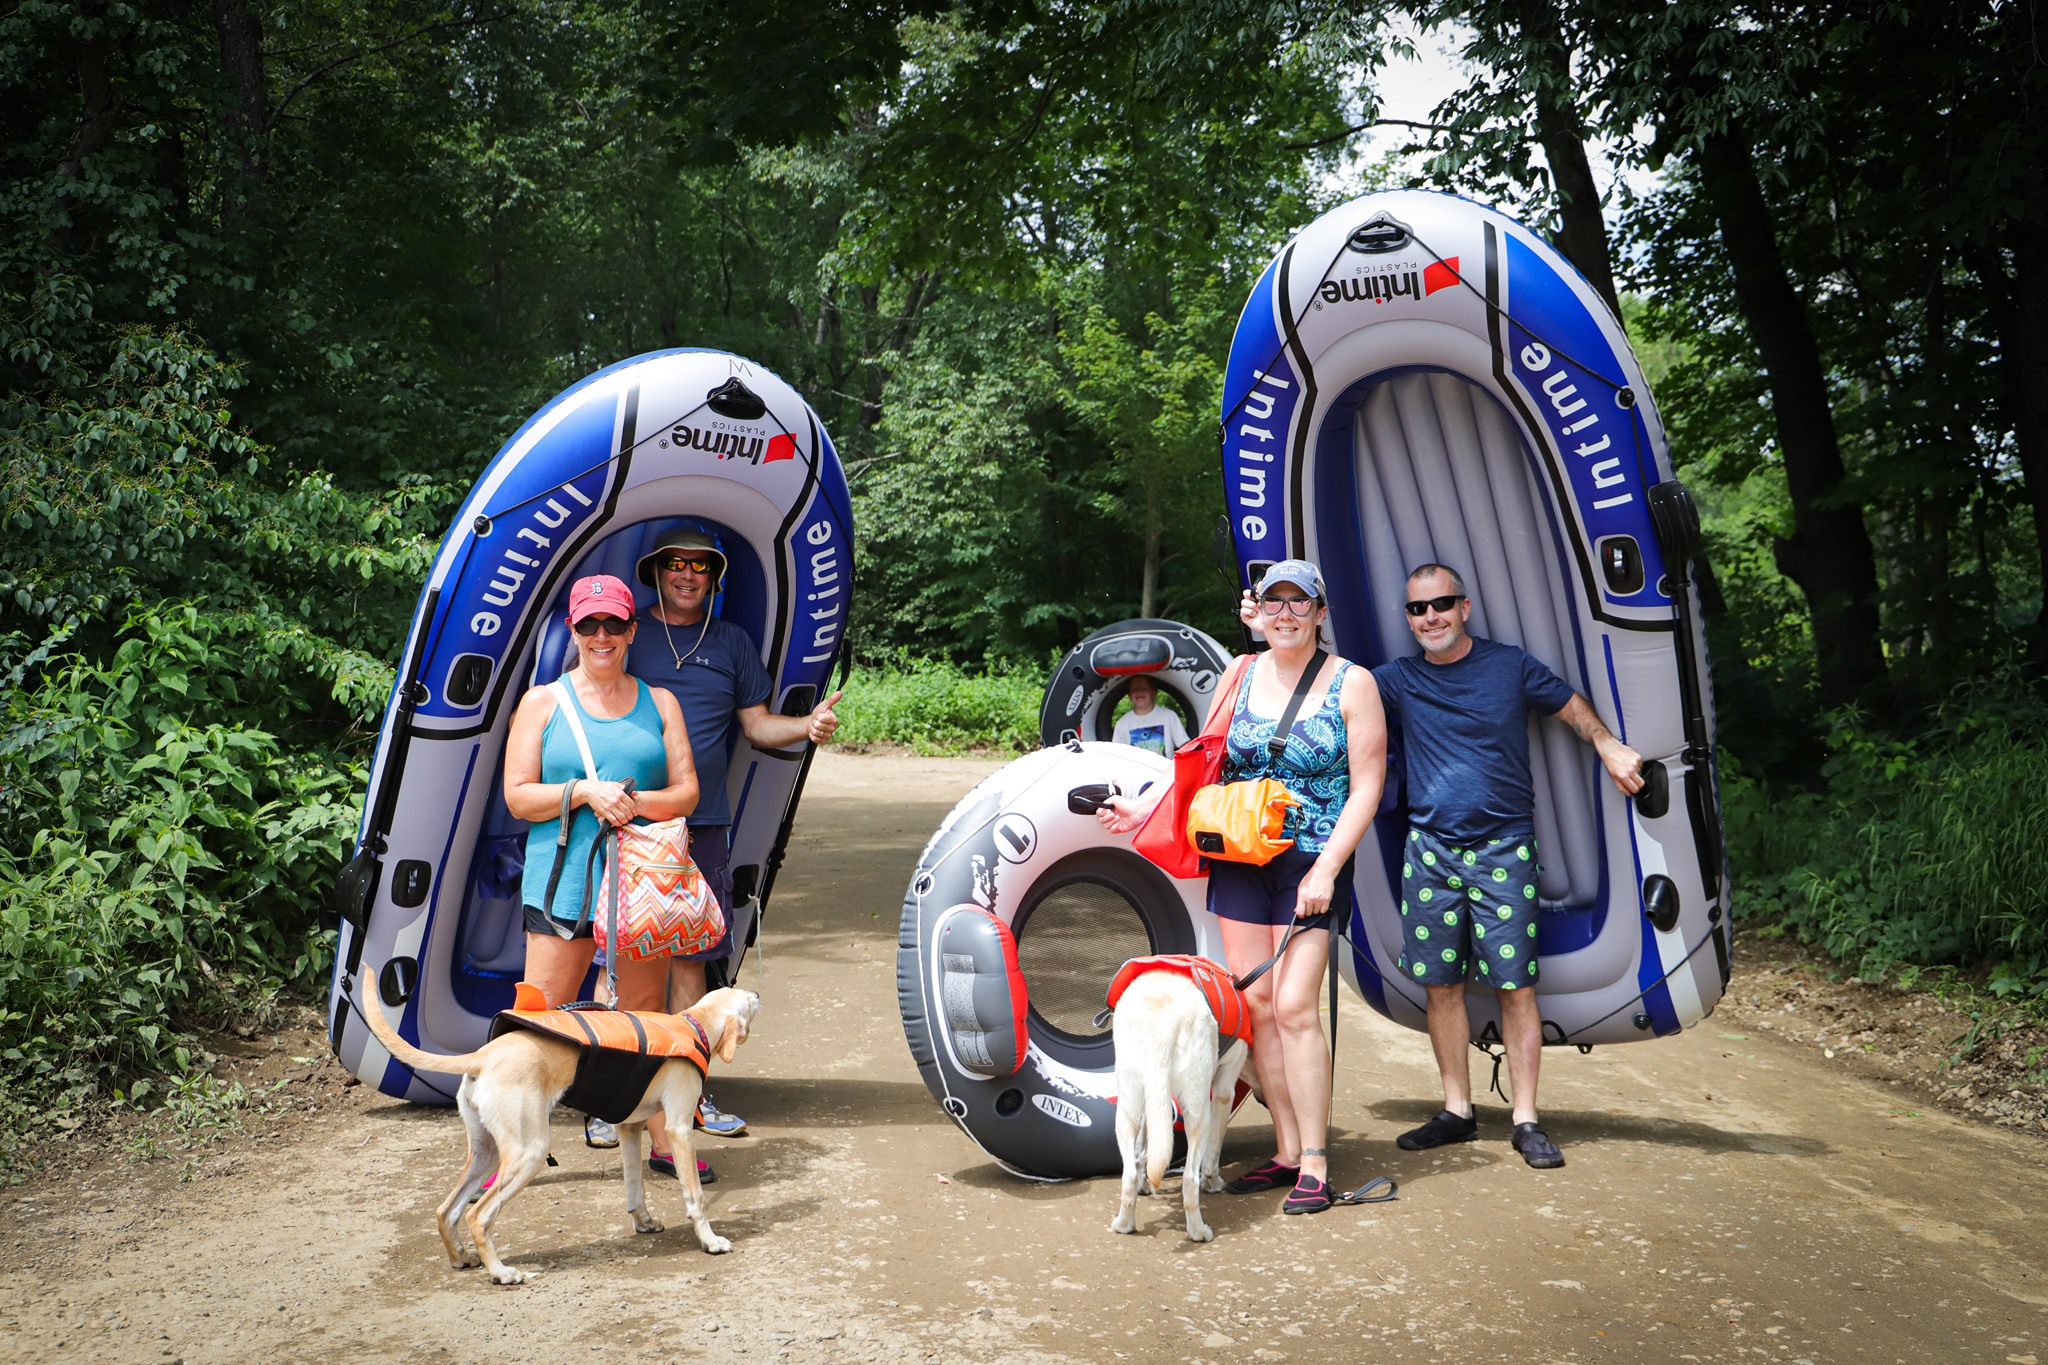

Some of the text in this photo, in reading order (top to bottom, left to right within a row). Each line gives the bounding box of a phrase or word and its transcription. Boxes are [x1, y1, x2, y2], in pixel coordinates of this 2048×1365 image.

[1355, 261, 1418, 275] PLASTICS
[711, 421, 766, 436] PLASTICS
[1520, 342, 1634, 510] Intime
[1239, 369, 1290, 541] Intime
[470, 483, 594, 637] Intime
[591, 580, 604, 595] B
[802, 520, 840, 663] Intime
[1067, 689, 1083, 711] INTEX
[1041, 1095, 1083, 1125] INTEX
